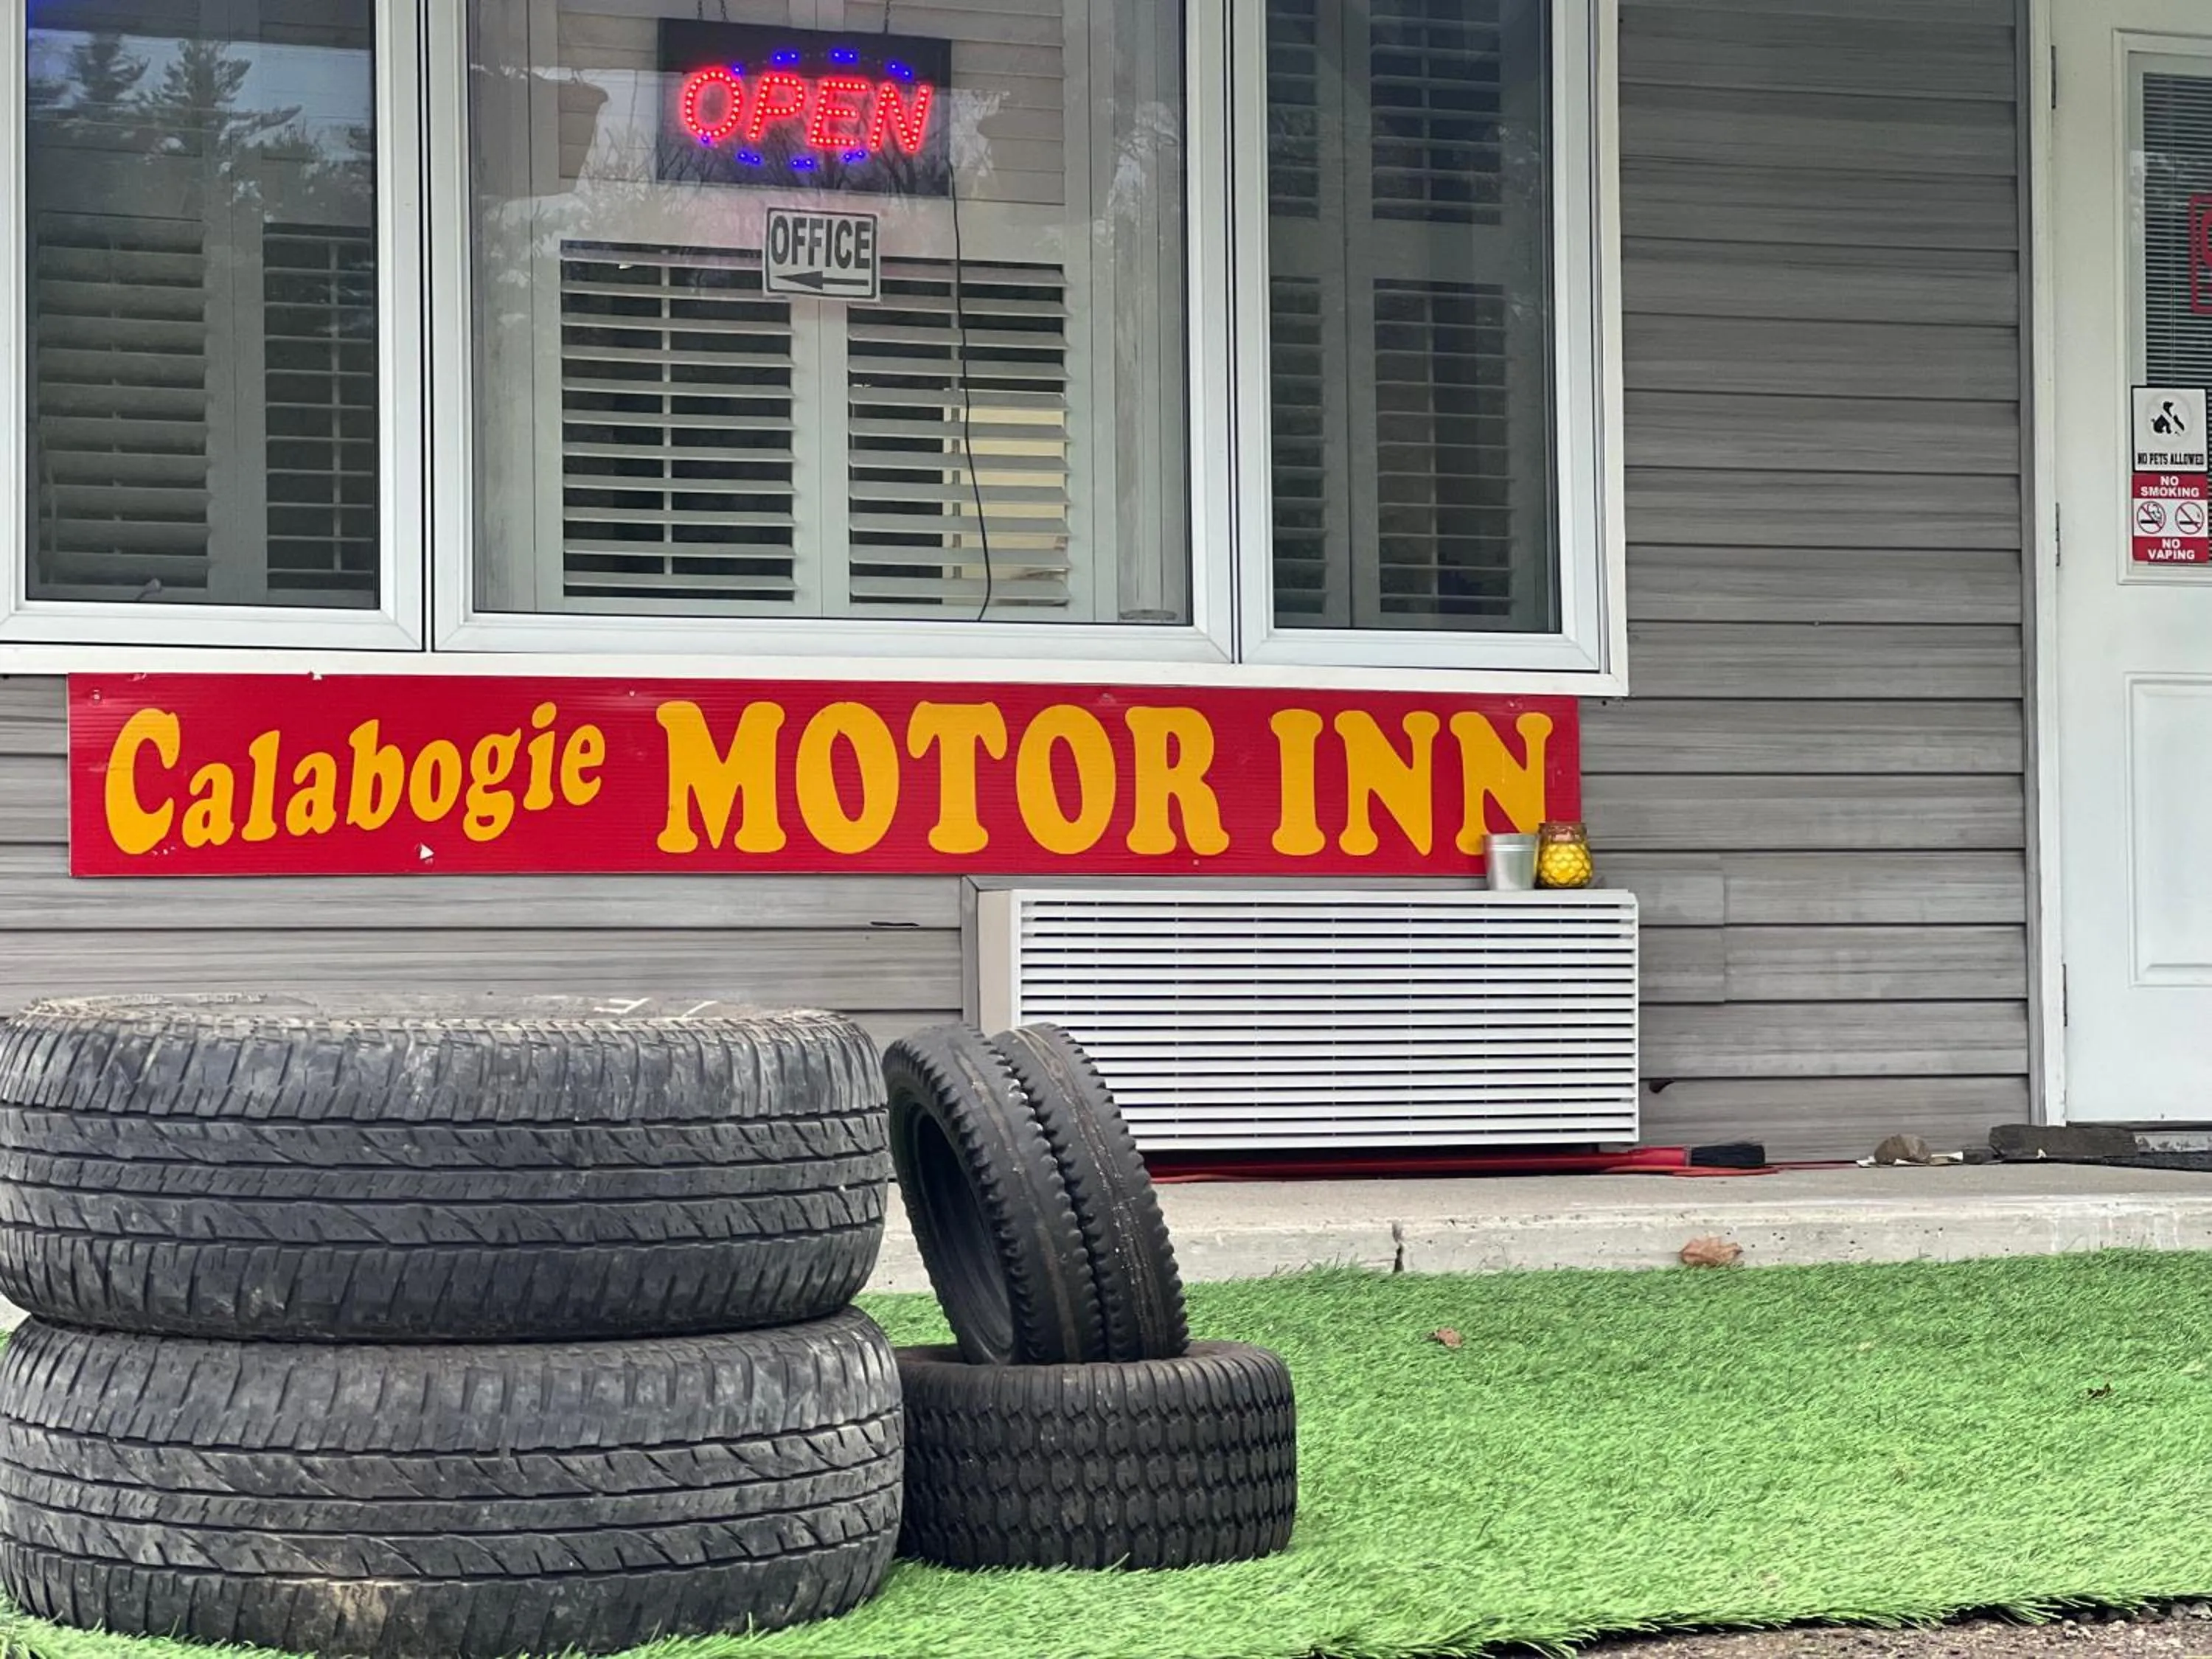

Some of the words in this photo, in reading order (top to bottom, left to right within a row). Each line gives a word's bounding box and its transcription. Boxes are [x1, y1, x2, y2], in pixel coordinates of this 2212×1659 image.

[683, 68, 933, 153] OPEN
[771, 215, 871, 269] OFFICE
[2138, 453, 2147, 465] NO
[2149, 453, 2168, 465] PETS
[2170, 453, 2204, 465] ALLOWED
[2160, 476, 2179, 486] NO
[2140, 486, 2199, 498] SMOKING
[2162, 538, 2180, 549] NO
[2147, 549, 2195, 560] VAPING
[105, 701, 605, 855] Calabogie
[656, 700, 1230, 855] MOTOR
[1270, 708, 1554, 858] INN
